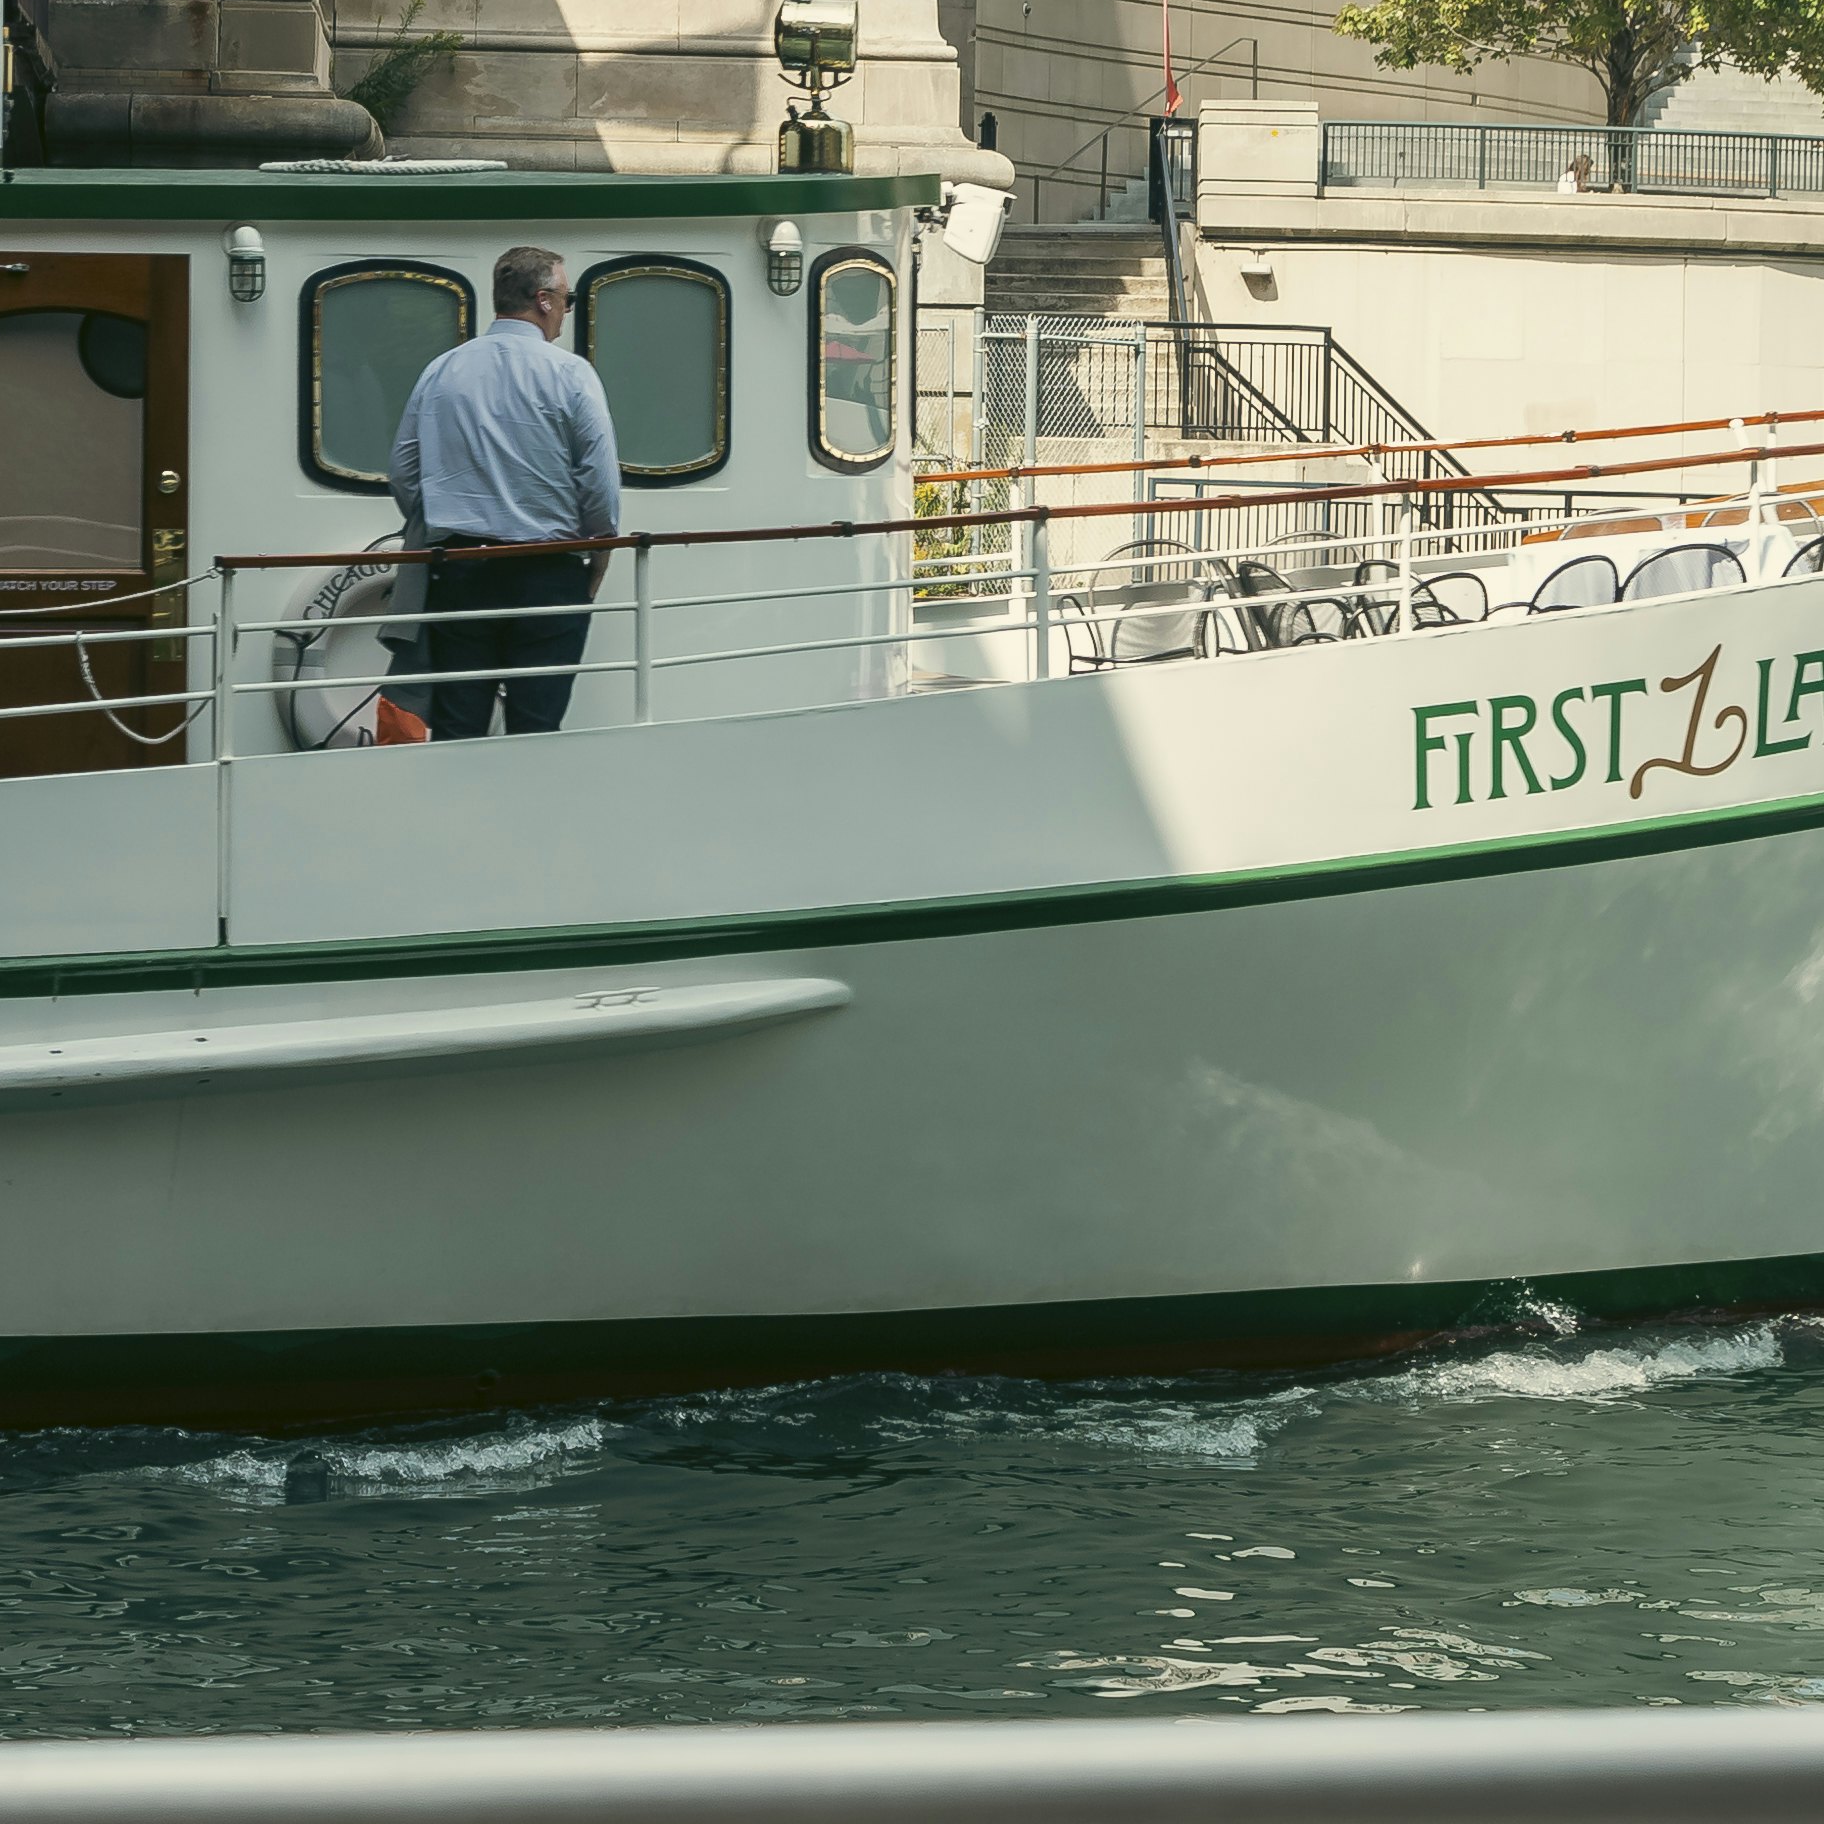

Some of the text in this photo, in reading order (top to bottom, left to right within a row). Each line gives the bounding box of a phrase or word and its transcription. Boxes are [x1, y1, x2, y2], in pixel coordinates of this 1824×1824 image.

[39, 580, 78, 591] YOUR
[80, 580, 118, 591] STEP
[1410, 677, 1649, 811] FIRST
